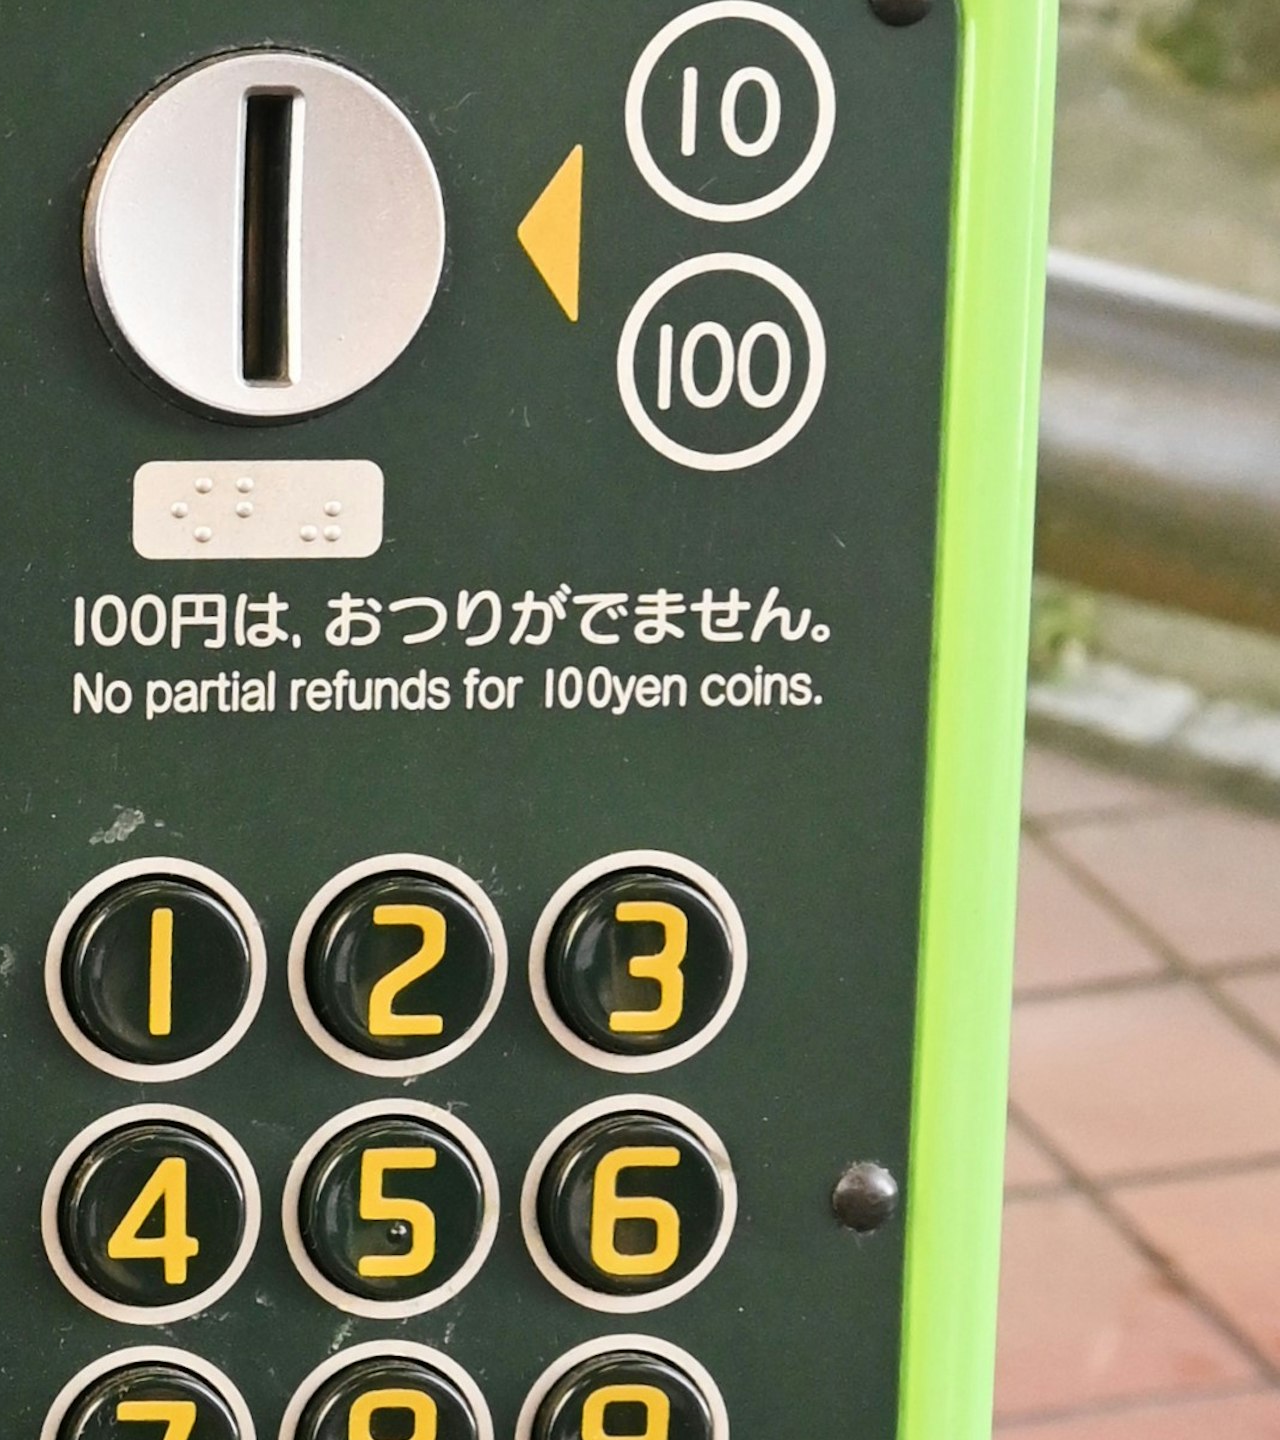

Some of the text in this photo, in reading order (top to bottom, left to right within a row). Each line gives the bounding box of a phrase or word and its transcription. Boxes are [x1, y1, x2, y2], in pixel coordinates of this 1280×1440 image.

[681, 67, 781, 157] 10
[658, 321, 793, 410] 100
[74, 665, 822, 720] No partial refunds for 100yen coins.
[150, 909, 172, 1035] 1
[369, 906, 445, 1035] 2
[609, 903, 687, 1031] 3
[108, 1158, 198, 1284] 4
[359, 1148, 436, 1277] 5
[591, 1148, 679, 1275] 6
